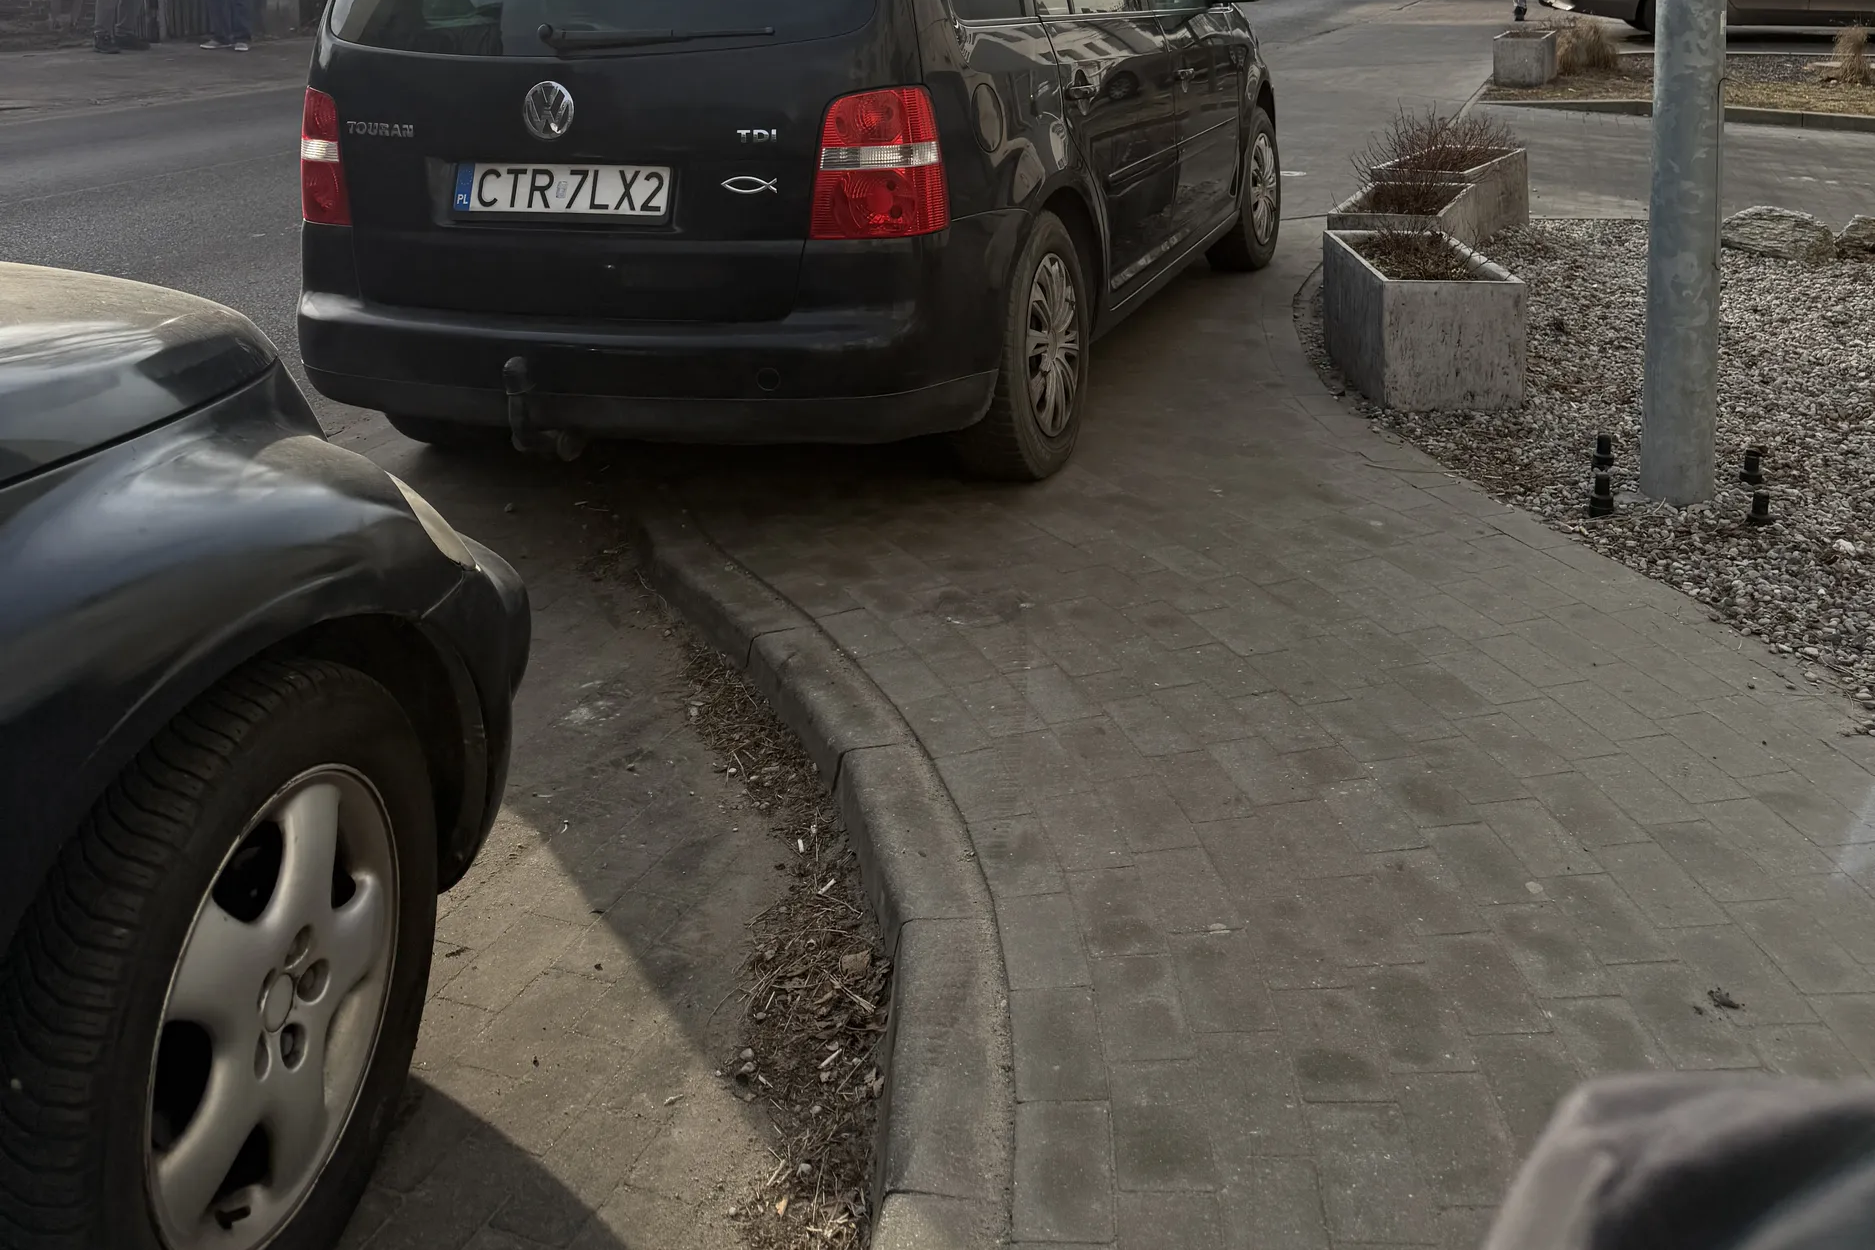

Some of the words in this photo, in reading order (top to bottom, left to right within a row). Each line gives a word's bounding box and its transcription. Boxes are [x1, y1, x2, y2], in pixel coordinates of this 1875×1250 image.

[346, 120, 415, 138] TOURAN
[736, 128, 777, 143] TDI
[478, 168, 555, 209] CTR
[565, 168, 665, 212] 7LX2
[456, 193, 469, 205] PL
